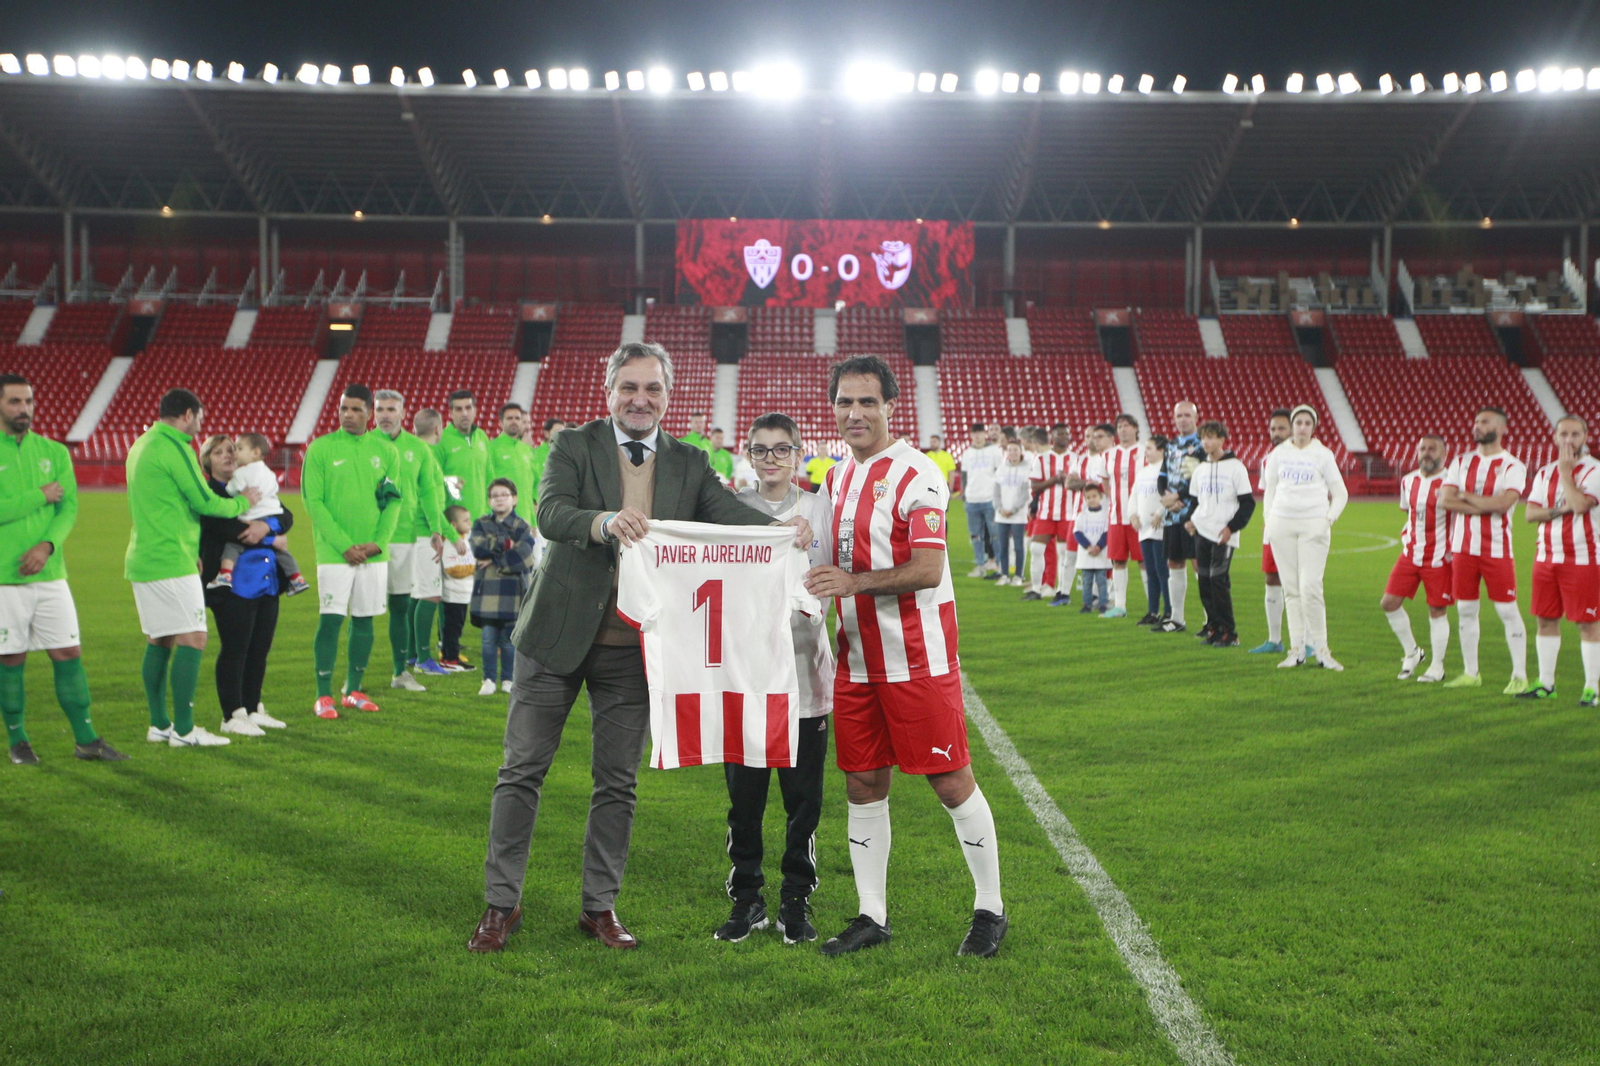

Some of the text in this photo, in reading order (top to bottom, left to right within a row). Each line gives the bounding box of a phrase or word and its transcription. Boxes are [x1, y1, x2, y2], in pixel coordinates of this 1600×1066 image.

[791, 253, 813, 281] 0
[838, 253, 860, 281] 0
[654, 545, 772, 569] JAVIER AURELIANO
[692, 579, 723, 668] 1
